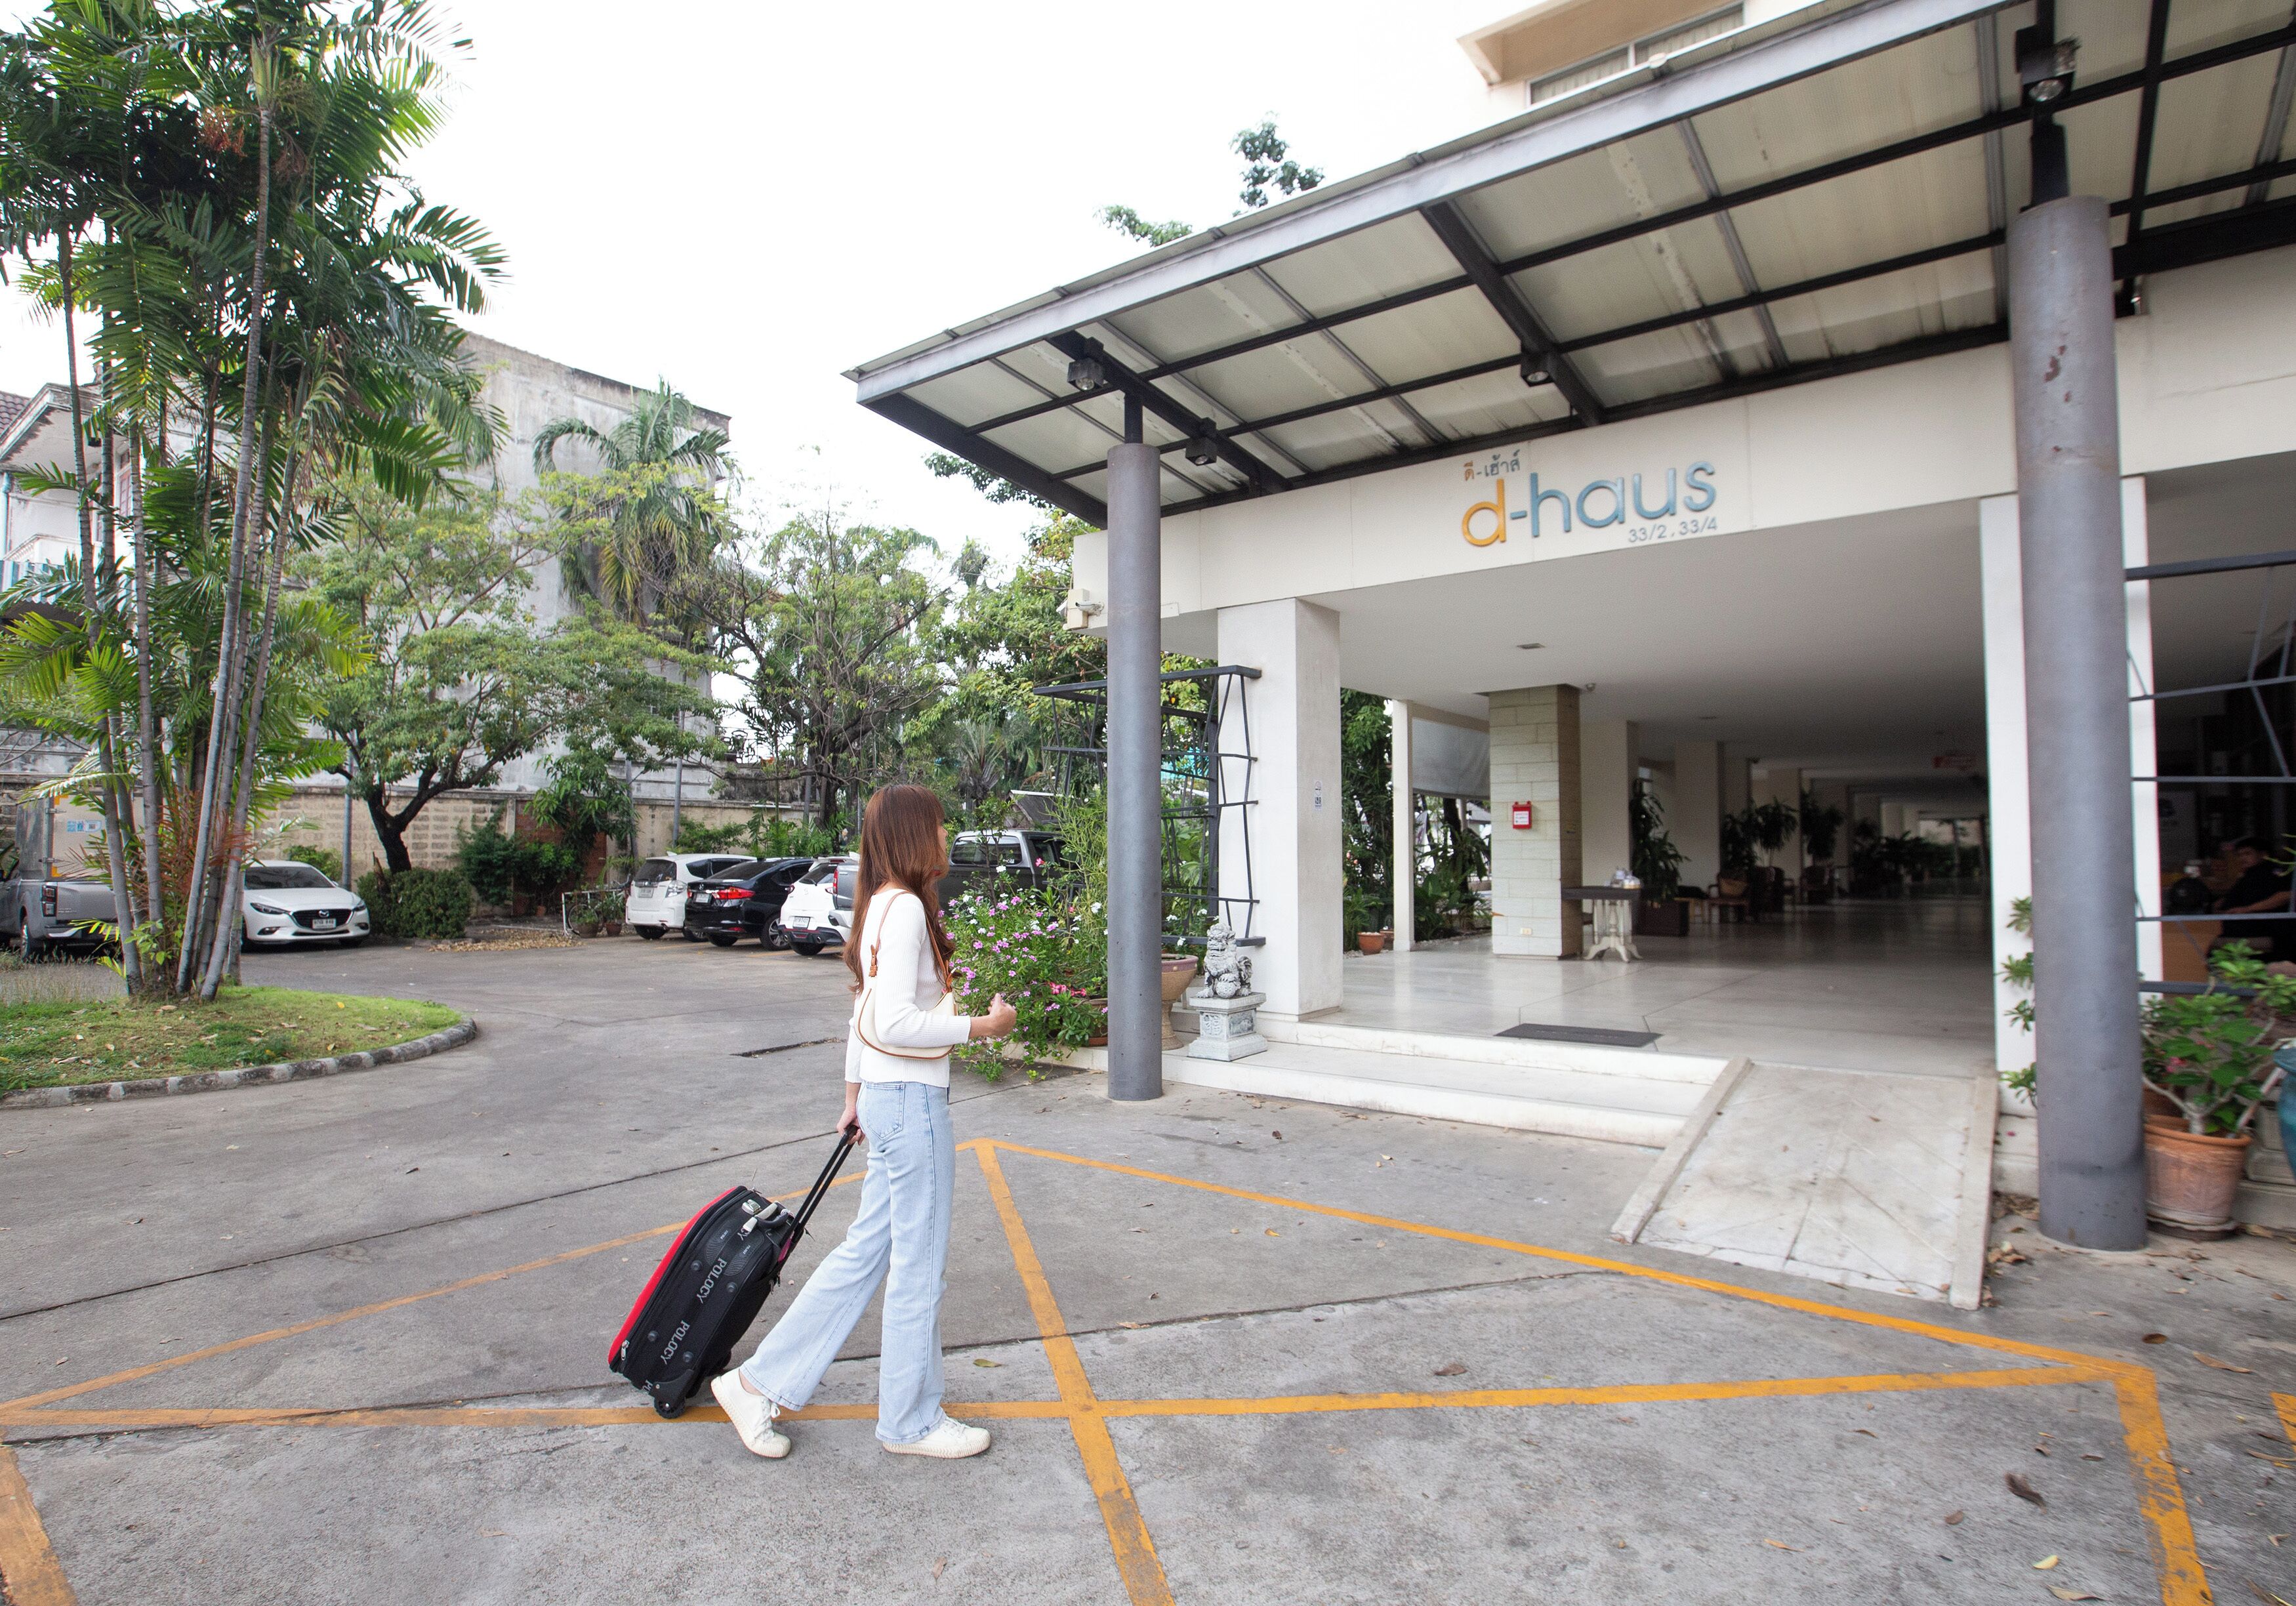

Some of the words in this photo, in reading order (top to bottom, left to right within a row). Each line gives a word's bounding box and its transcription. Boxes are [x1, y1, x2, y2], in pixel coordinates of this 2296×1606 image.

[1462, 461, 1717, 546] d-haus
[1679, 516, 1717, 535] 33/4
[696, 1257, 728, 1304] POLOCY
[661, 1320, 690, 1365] POLOCY
